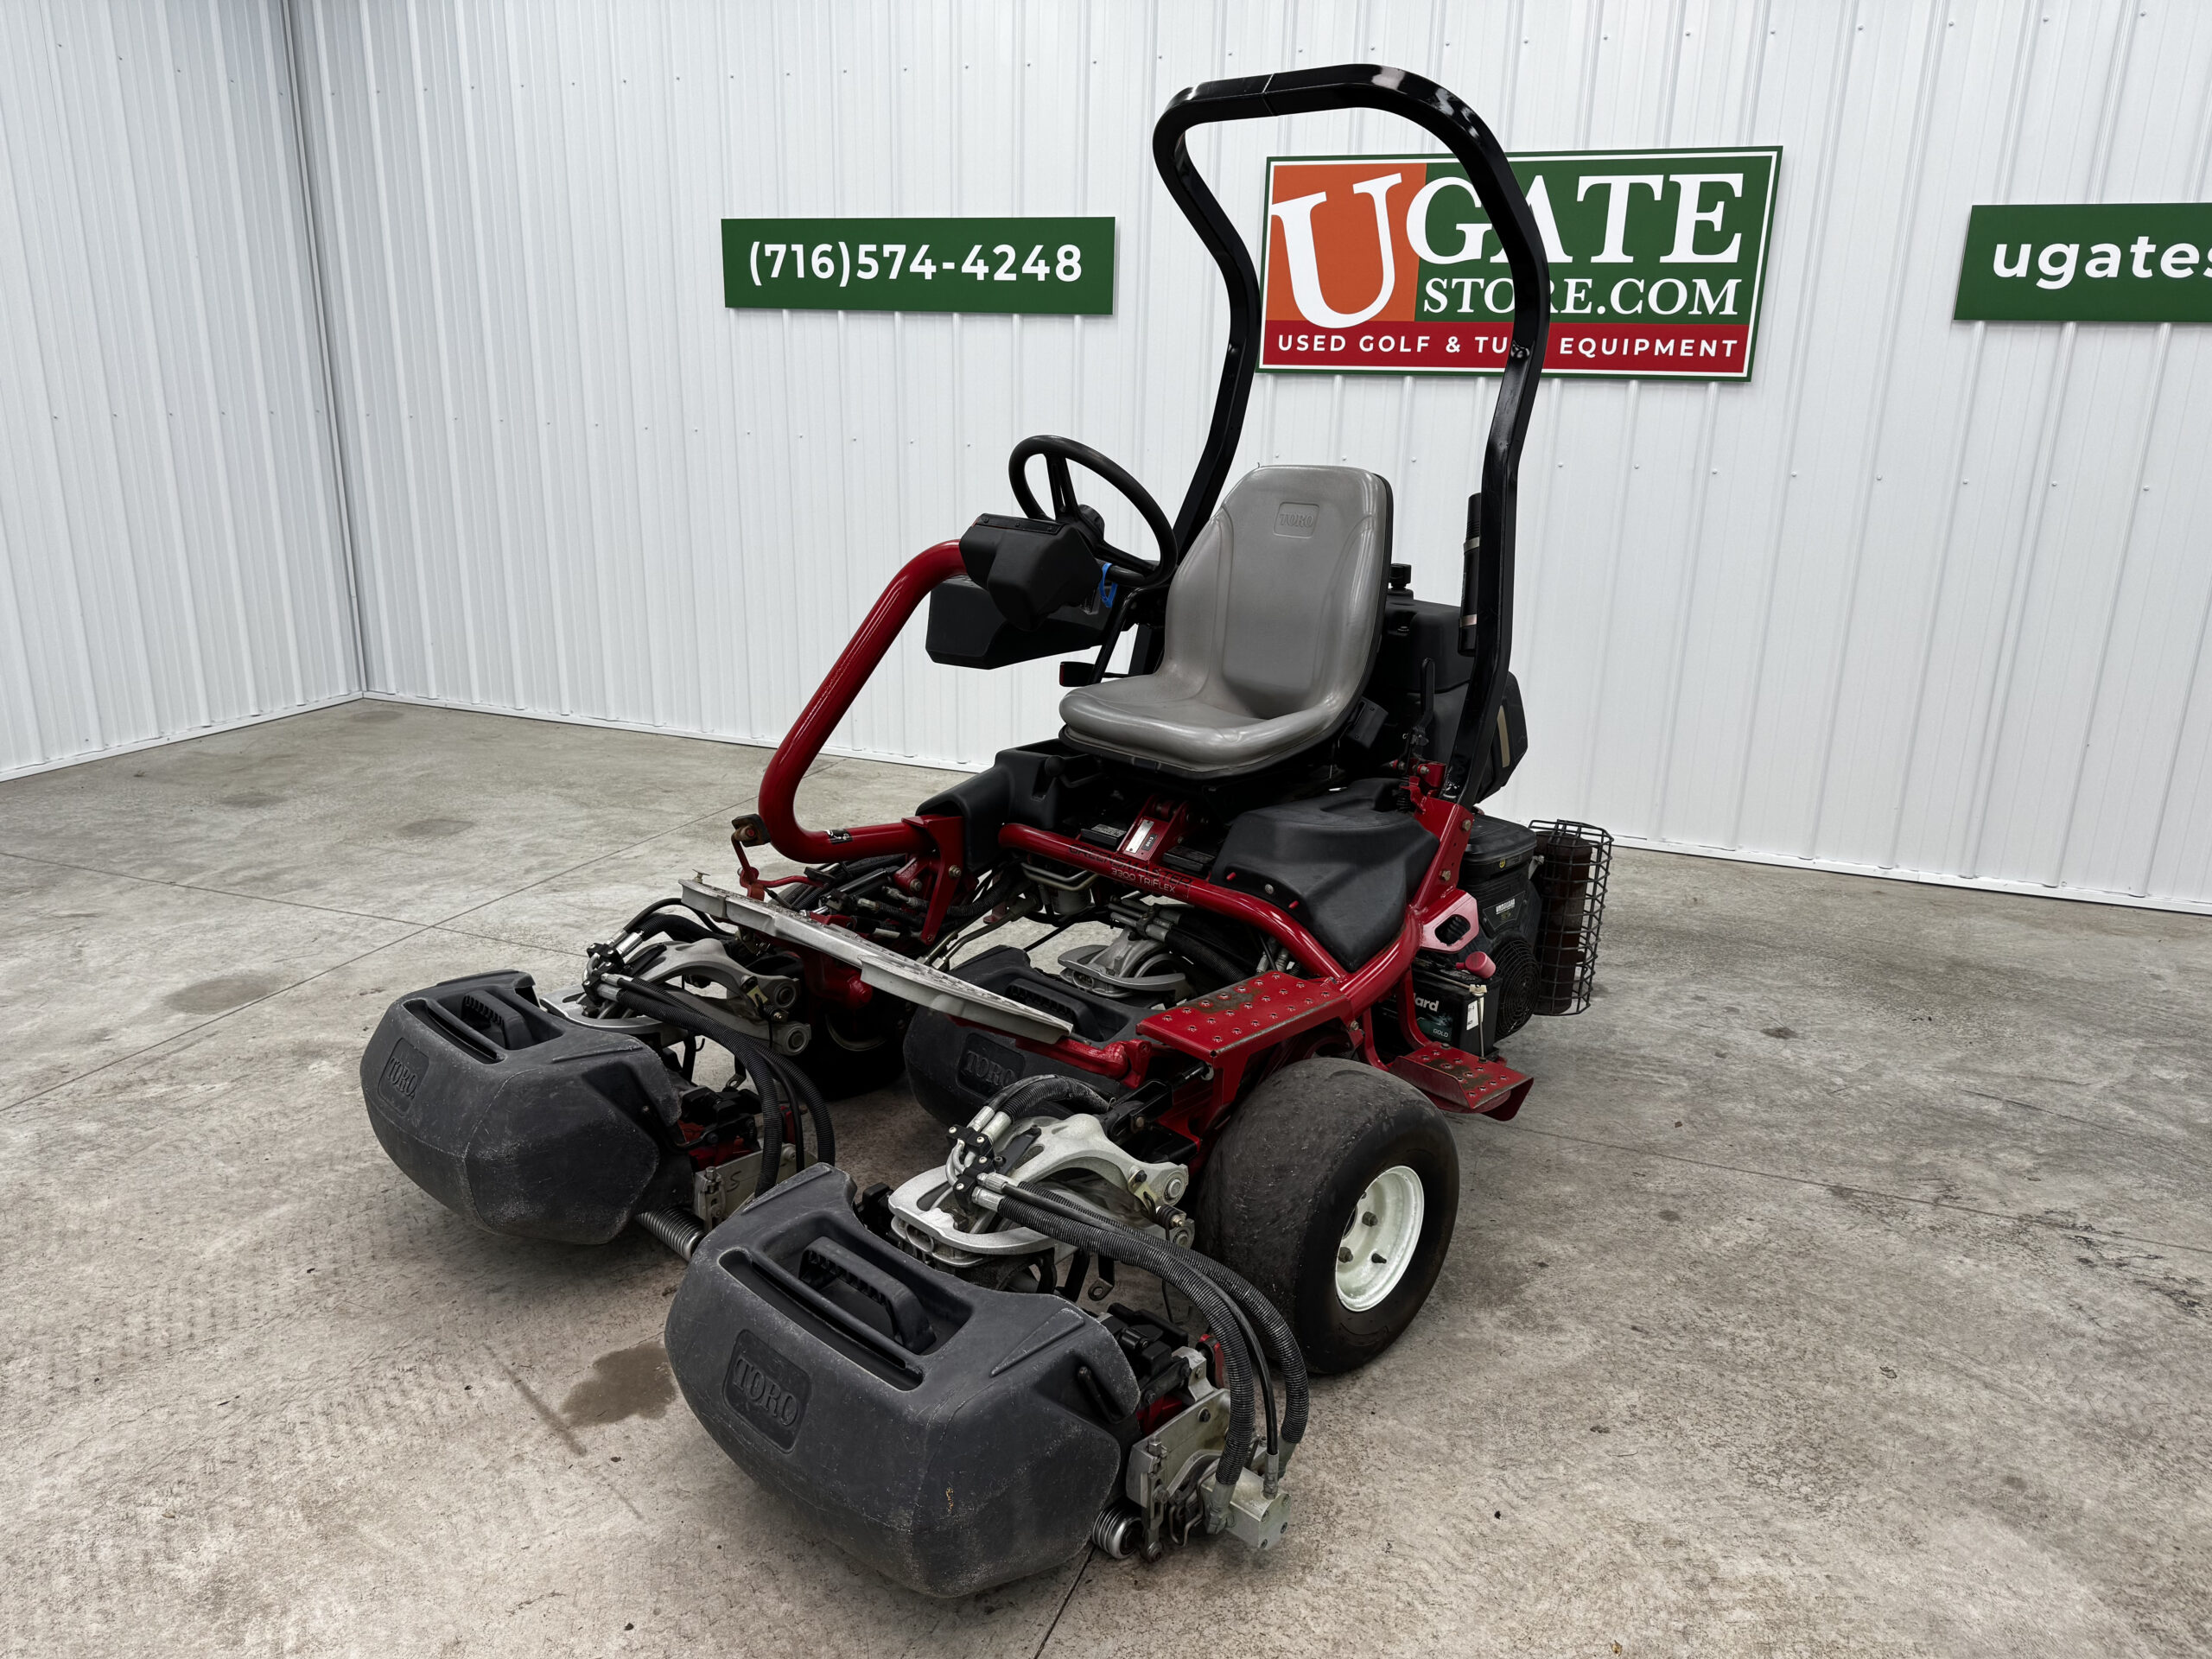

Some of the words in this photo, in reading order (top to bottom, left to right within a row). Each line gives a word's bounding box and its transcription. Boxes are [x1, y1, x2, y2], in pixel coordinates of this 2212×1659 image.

[750, 241, 1082, 287] (716)574-4248
[1993, 236, 2212, 289] ugate
[1278, 334, 1346, 352] USED
[1359, 335, 1430, 353] GOLF
[1446, 336, 1460, 353] &
[1474, 336, 1509, 353] TU
[1560, 338, 1738, 359] EQUIPMENT
[1279, 513, 1313, 528] TORO
[1111, 867, 1136, 880] 3300
[1433, 1028, 1449, 1038] GOLD
[389, 1057, 418, 1098] TORO
[965, 1050, 1017, 1089] TORO
[734, 1357, 799, 1427] TORO
